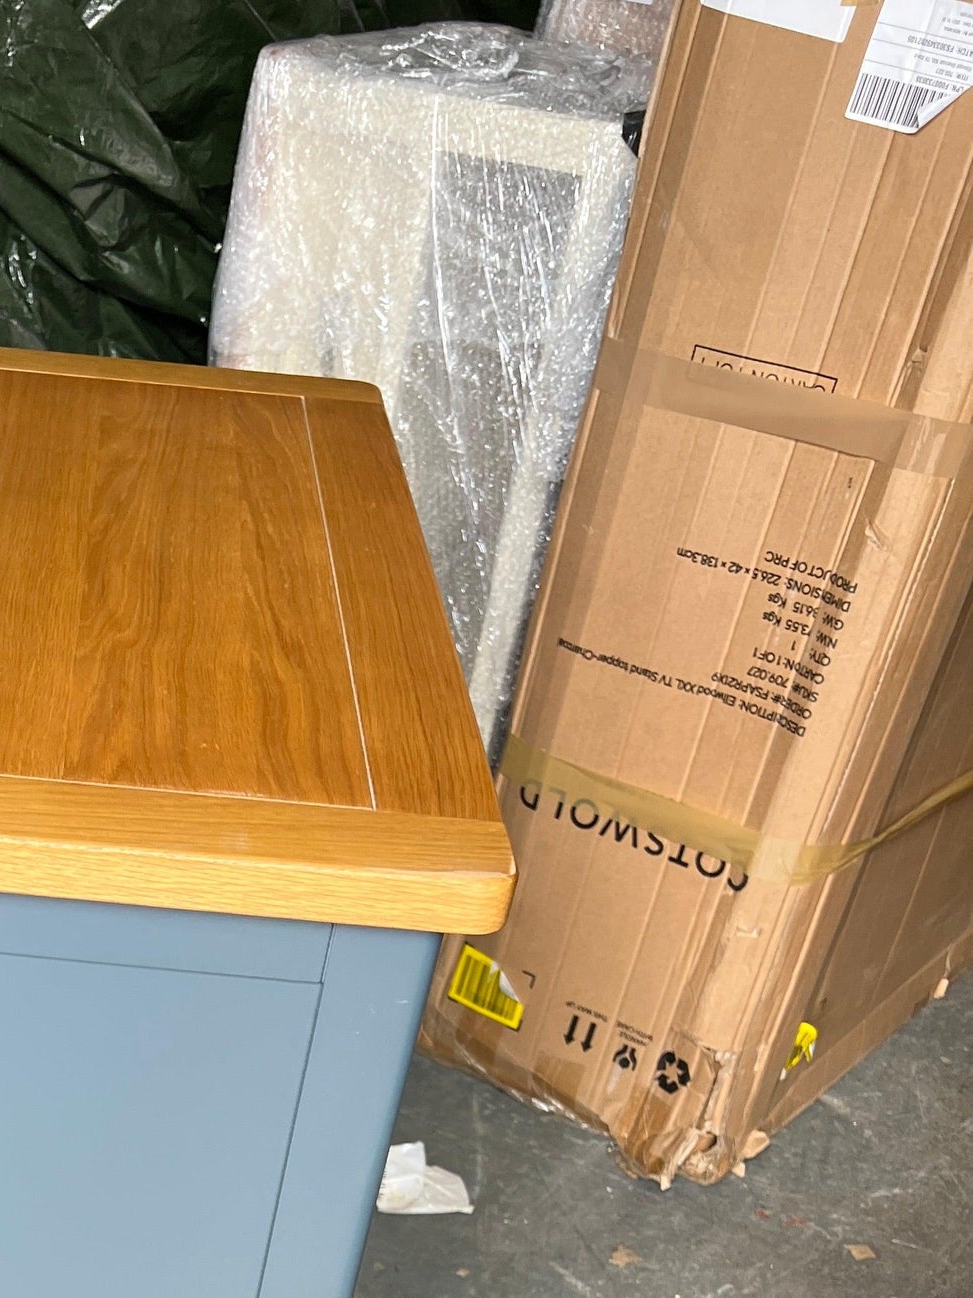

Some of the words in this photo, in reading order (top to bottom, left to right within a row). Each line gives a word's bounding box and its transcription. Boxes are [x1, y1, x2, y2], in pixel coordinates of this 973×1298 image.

[676, 547, 720, 569] 138.3cm
[764, 551, 789, 568] PRC
[789, 560, 807, 573] OF
[727, 561, 744, 576] 42
[751, 566, 782, 587] 226.5
[808, 566, 857, 593] PRODUCT
[767, 592, 787, 608] Kgs
[785, 578, 851, 612] DIMENSIONS:
[762, 611, 781, 627] Kgs
[758, 650, 775, 663] OF
[809, 648, 831, 666] QTY:
[629, 665, 658, 682] Stand
[783, 658, 825, 684] CARTON:
[658, 675, 673, 687] TV
[676, 678, 696, 694] XXL
[696, 685, 736, 707] Ellwood
[738, 700, 806, 737] DESCRIPTION:
